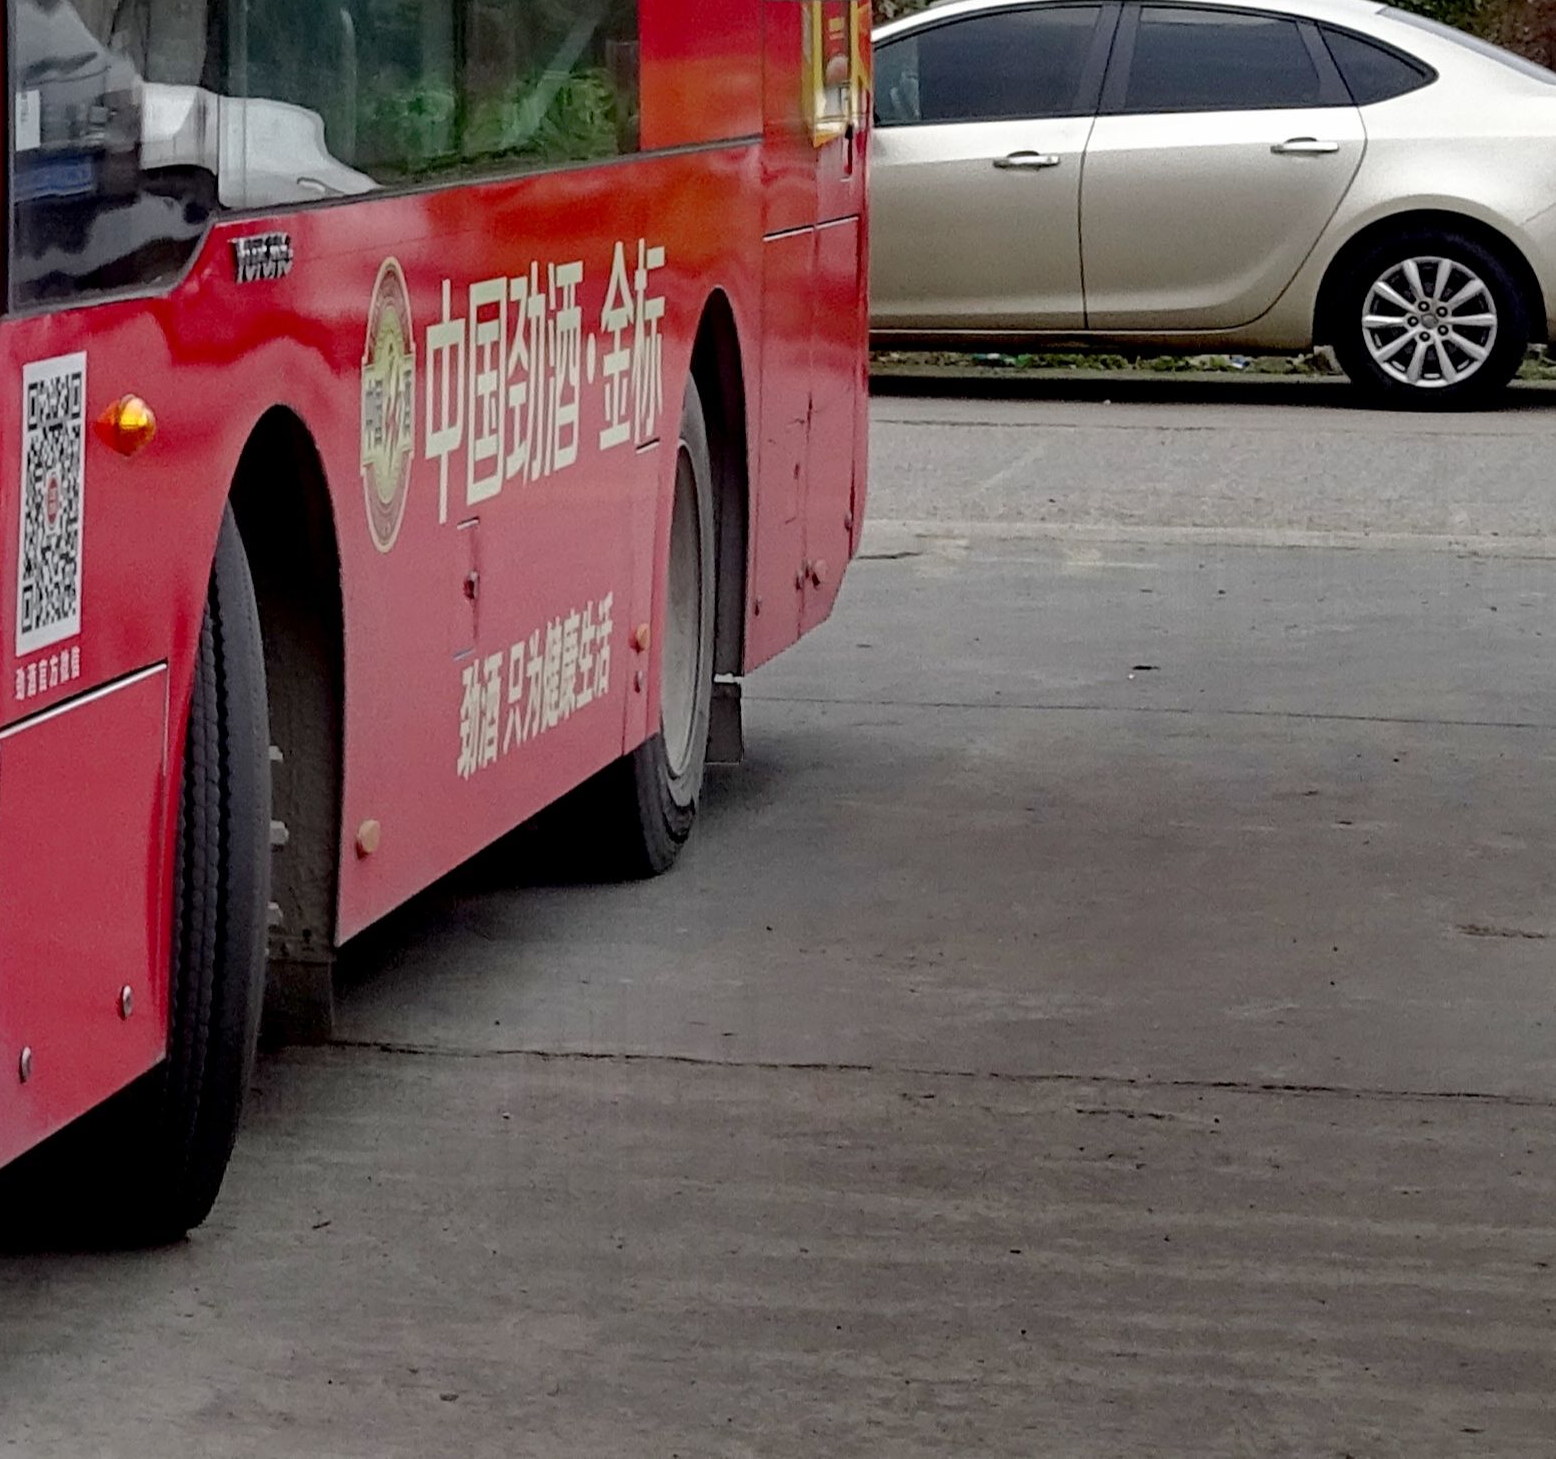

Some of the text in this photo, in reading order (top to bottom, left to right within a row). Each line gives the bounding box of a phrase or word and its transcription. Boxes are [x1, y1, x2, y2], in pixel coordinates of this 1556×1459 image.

[456, 593, 614, 781] 劲酒 只为健康生活
